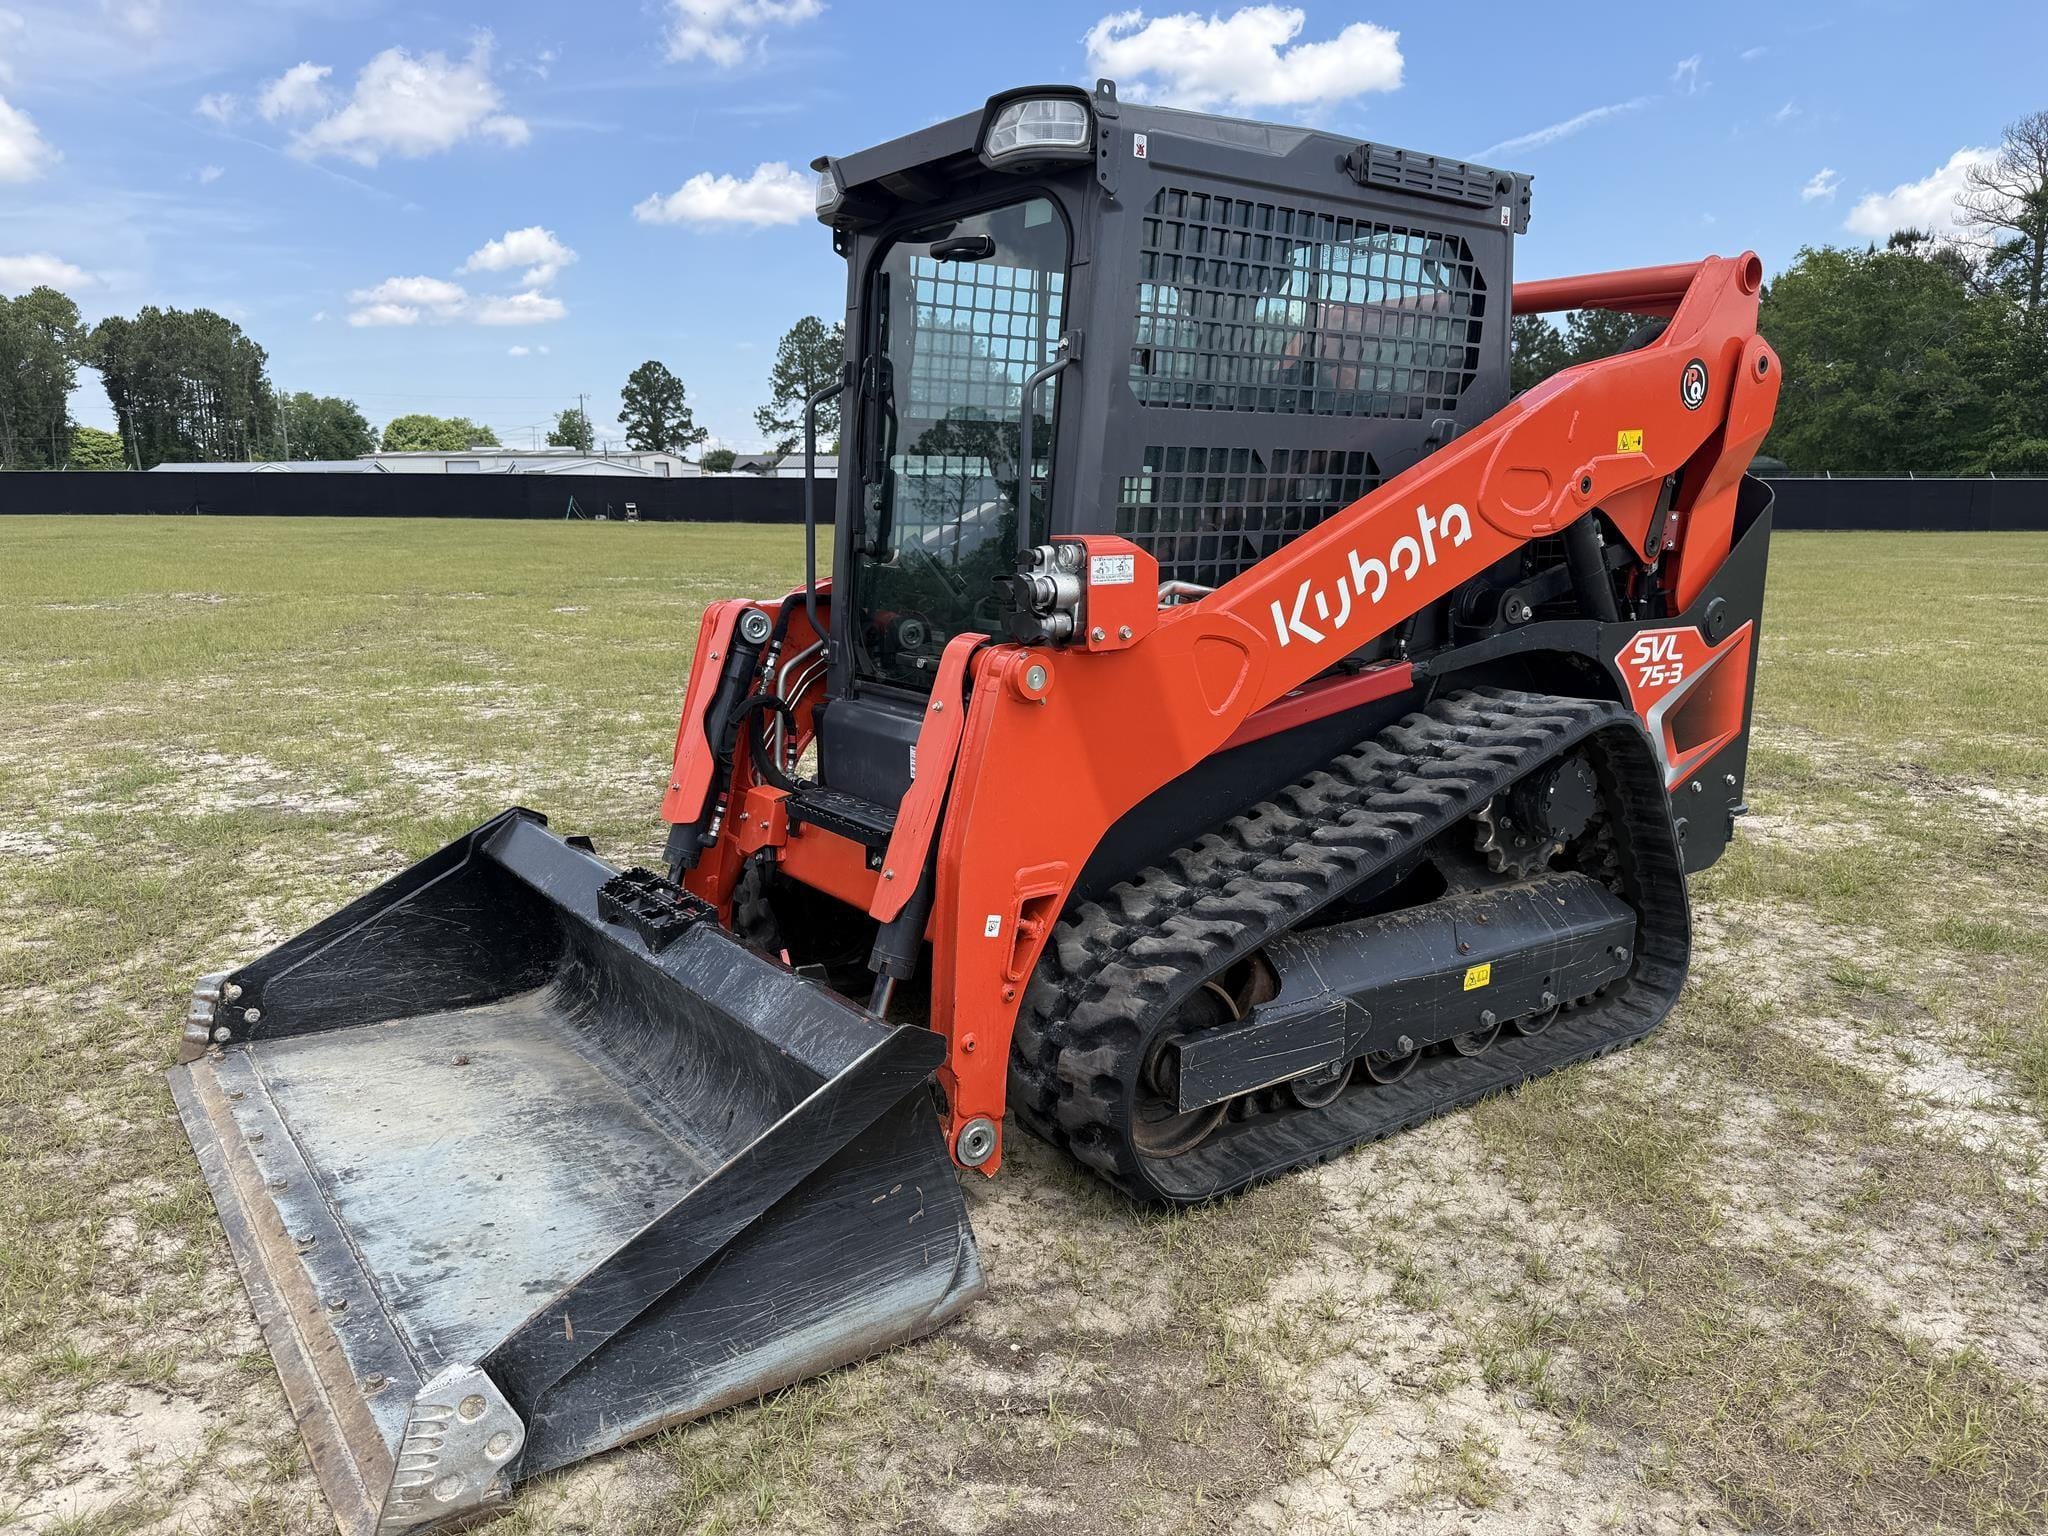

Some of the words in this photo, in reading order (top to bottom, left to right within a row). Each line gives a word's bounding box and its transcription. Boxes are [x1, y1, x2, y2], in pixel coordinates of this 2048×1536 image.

[1270, 503, 1473, 648] Kubota
[1630, 634, 1683, 665] SVL
[1638, 662, 1684, 688] 75-3
